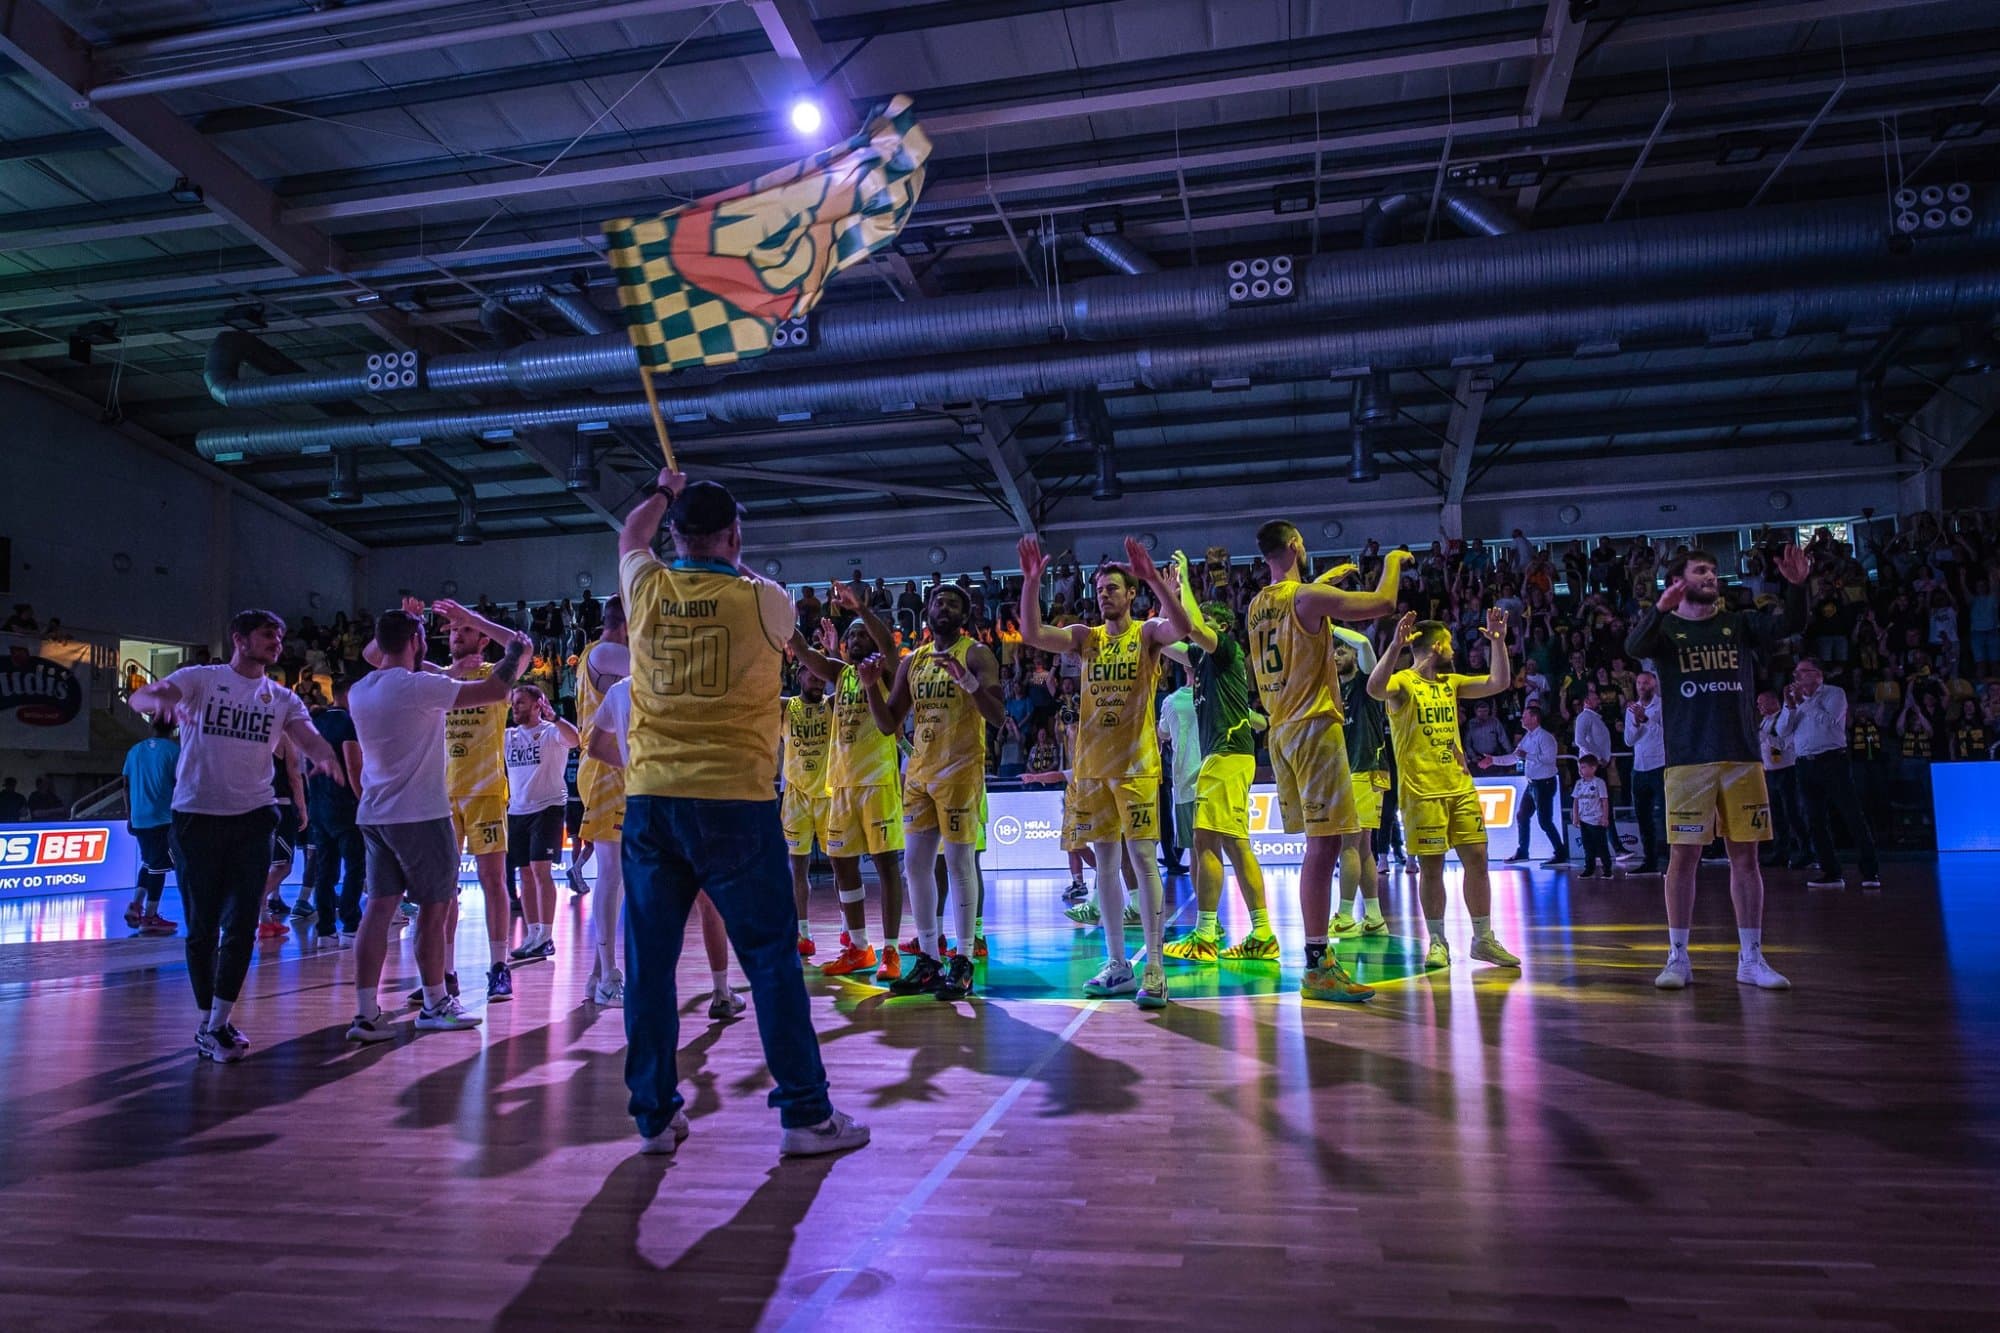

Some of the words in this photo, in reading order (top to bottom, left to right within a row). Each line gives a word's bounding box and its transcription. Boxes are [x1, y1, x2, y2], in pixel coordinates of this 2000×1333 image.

[661, 599, 718, 617] DALIBOY
[1104, 642, 1120, 656] 24
[1259, 628, 1283, 674] 15
[652, 624, 729, 697] 50
[1679, 650, 1739, 673] LEVICE
[1088, 662, 1137, 682] LEVICE
[1698, 681, 1743, 693] VEOLIA
[204, 703, 275, 735] LEVICE
[791, 721, 827, 739] LEVICE
[950, 815, 959, 832] 5
[1024, 821, 1050, 829] HRAJ
[1131, 810, 1151, 828] 24
[1750, 811, 1769, 829] 47
[483, 826, 498, 844] 31
[880, 826, 887, 841] 7
[998, 825, 1018, 836] 18+
[43, 834, 103, 861] BET
[23, 876, 42, 888] OD
